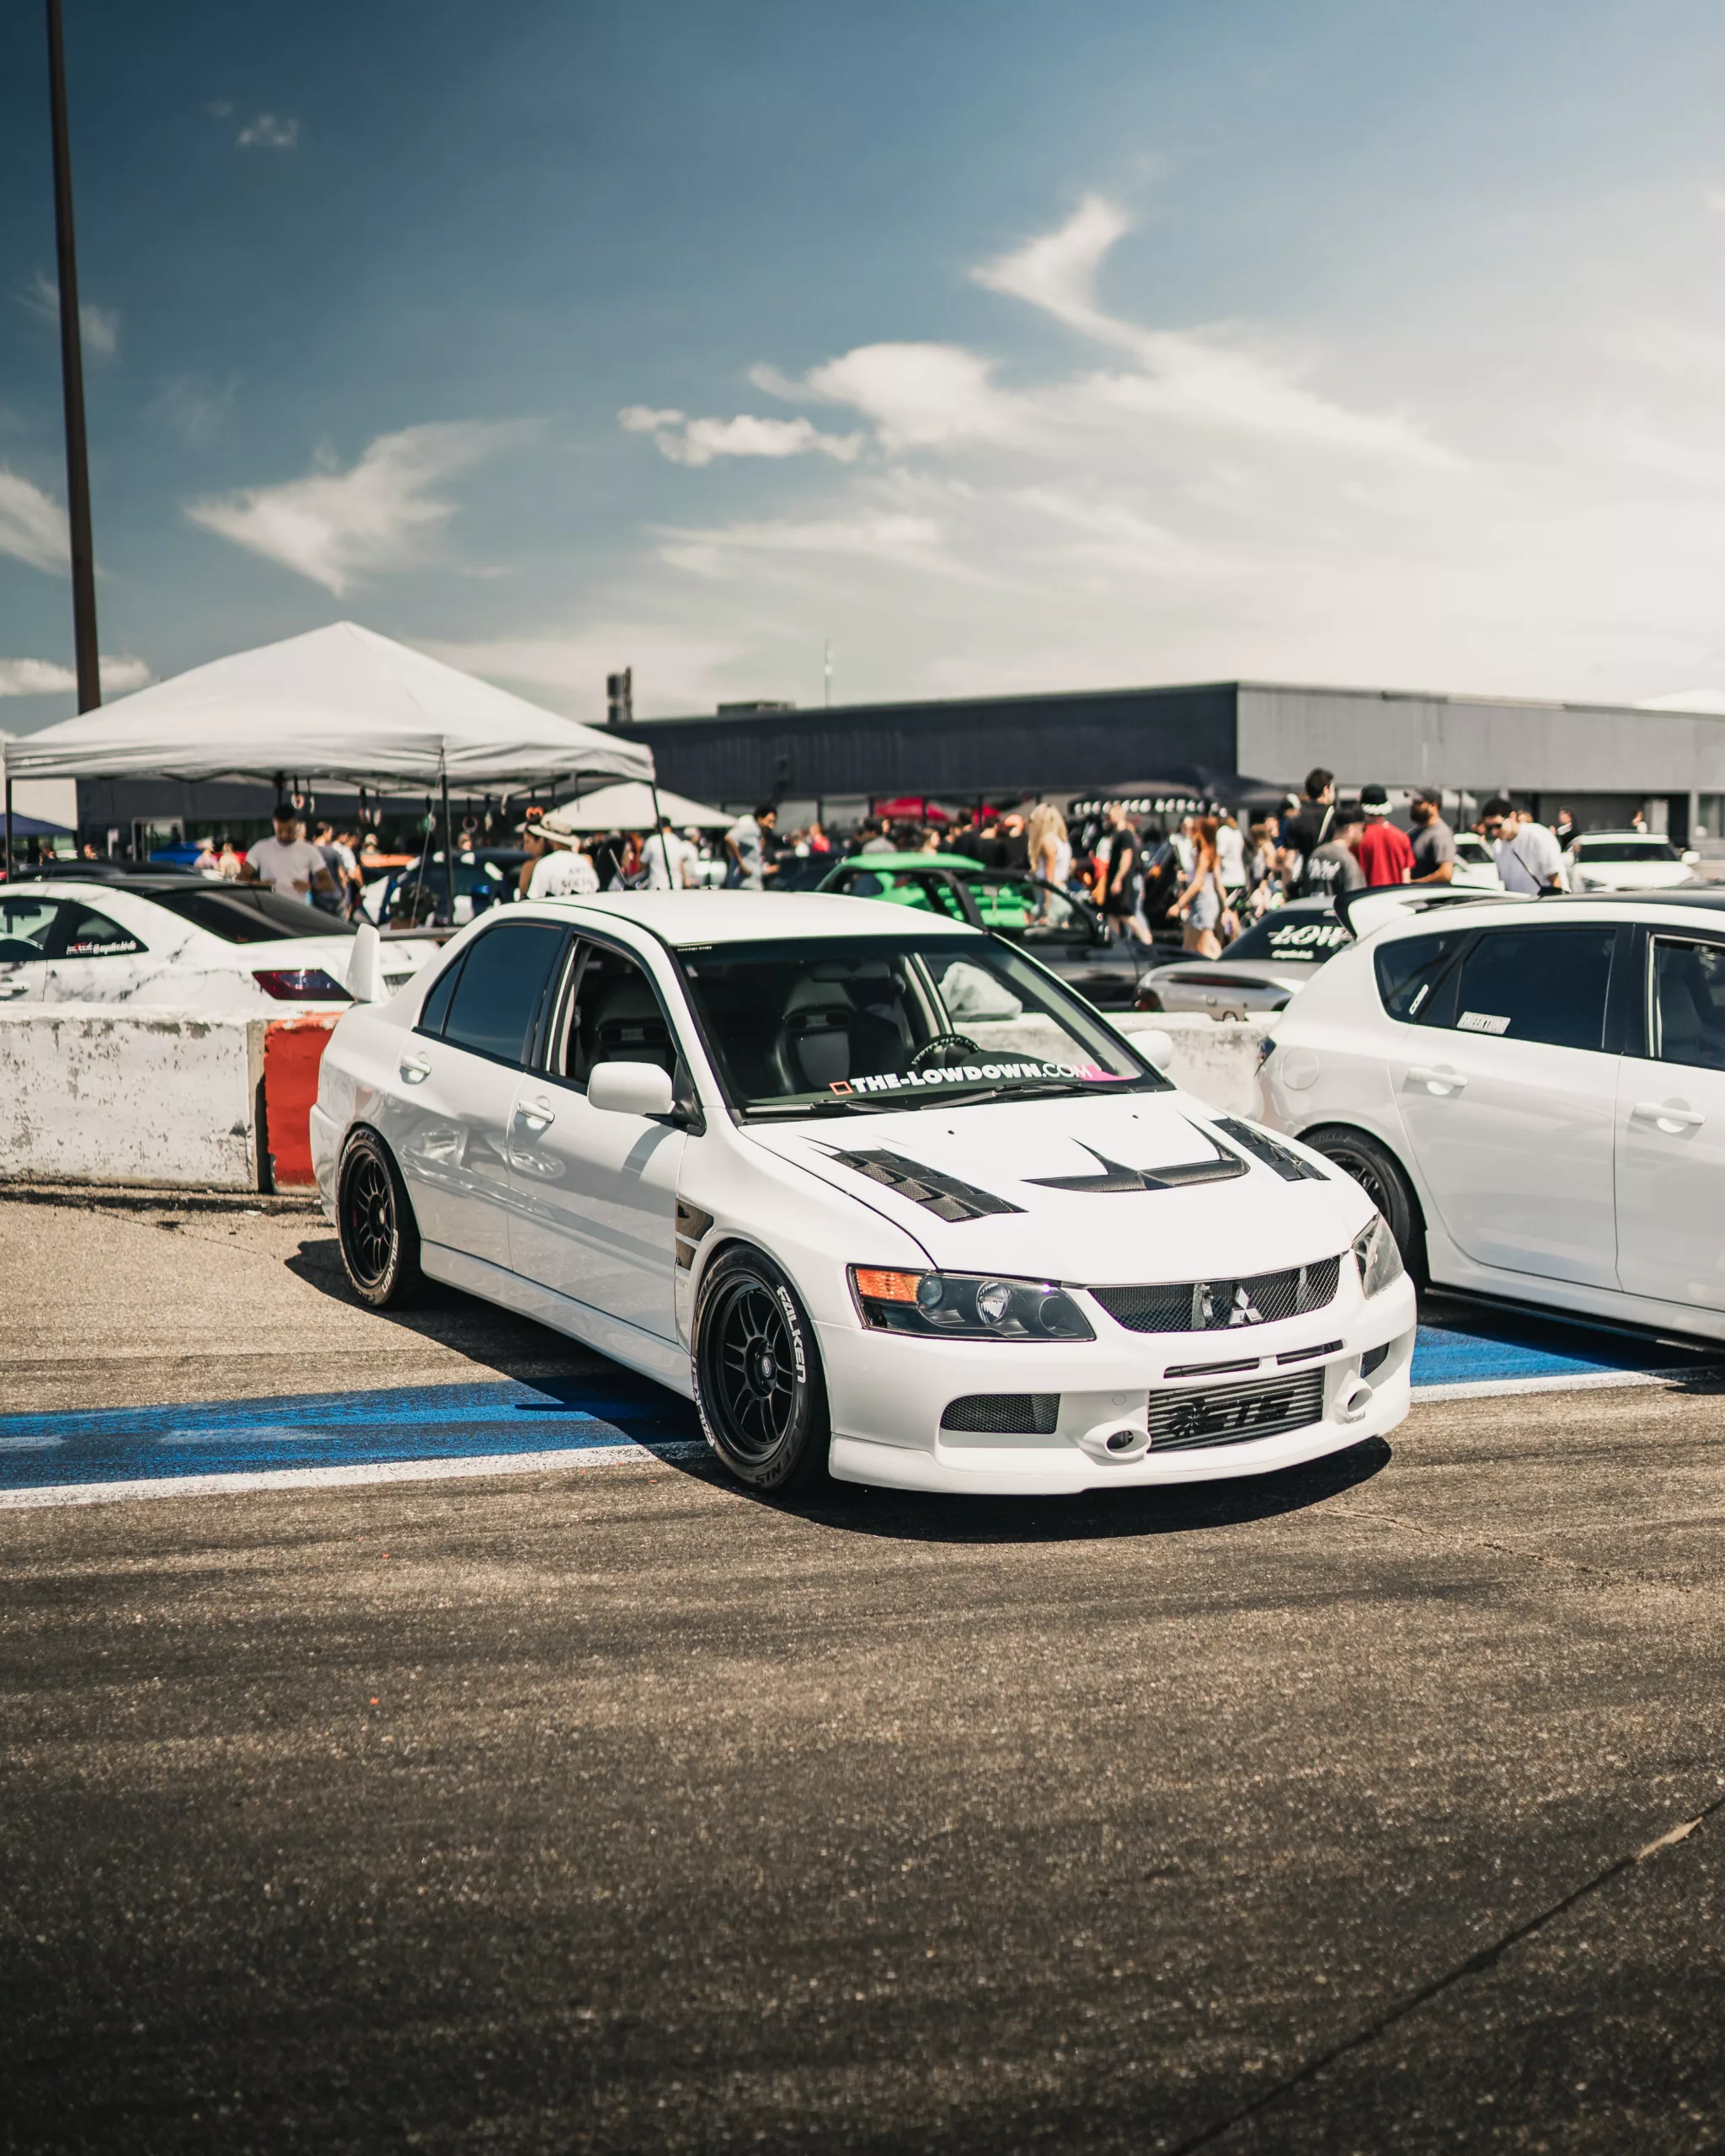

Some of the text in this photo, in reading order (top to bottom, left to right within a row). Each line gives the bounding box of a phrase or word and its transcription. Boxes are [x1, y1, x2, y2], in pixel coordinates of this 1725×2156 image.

[849, 1063, 1093, 1094] THE-LOWDOWN.COM
[382, 1228, 399, 1294] FALKEN
[776, 1283, 807, 1385] FALKEN
